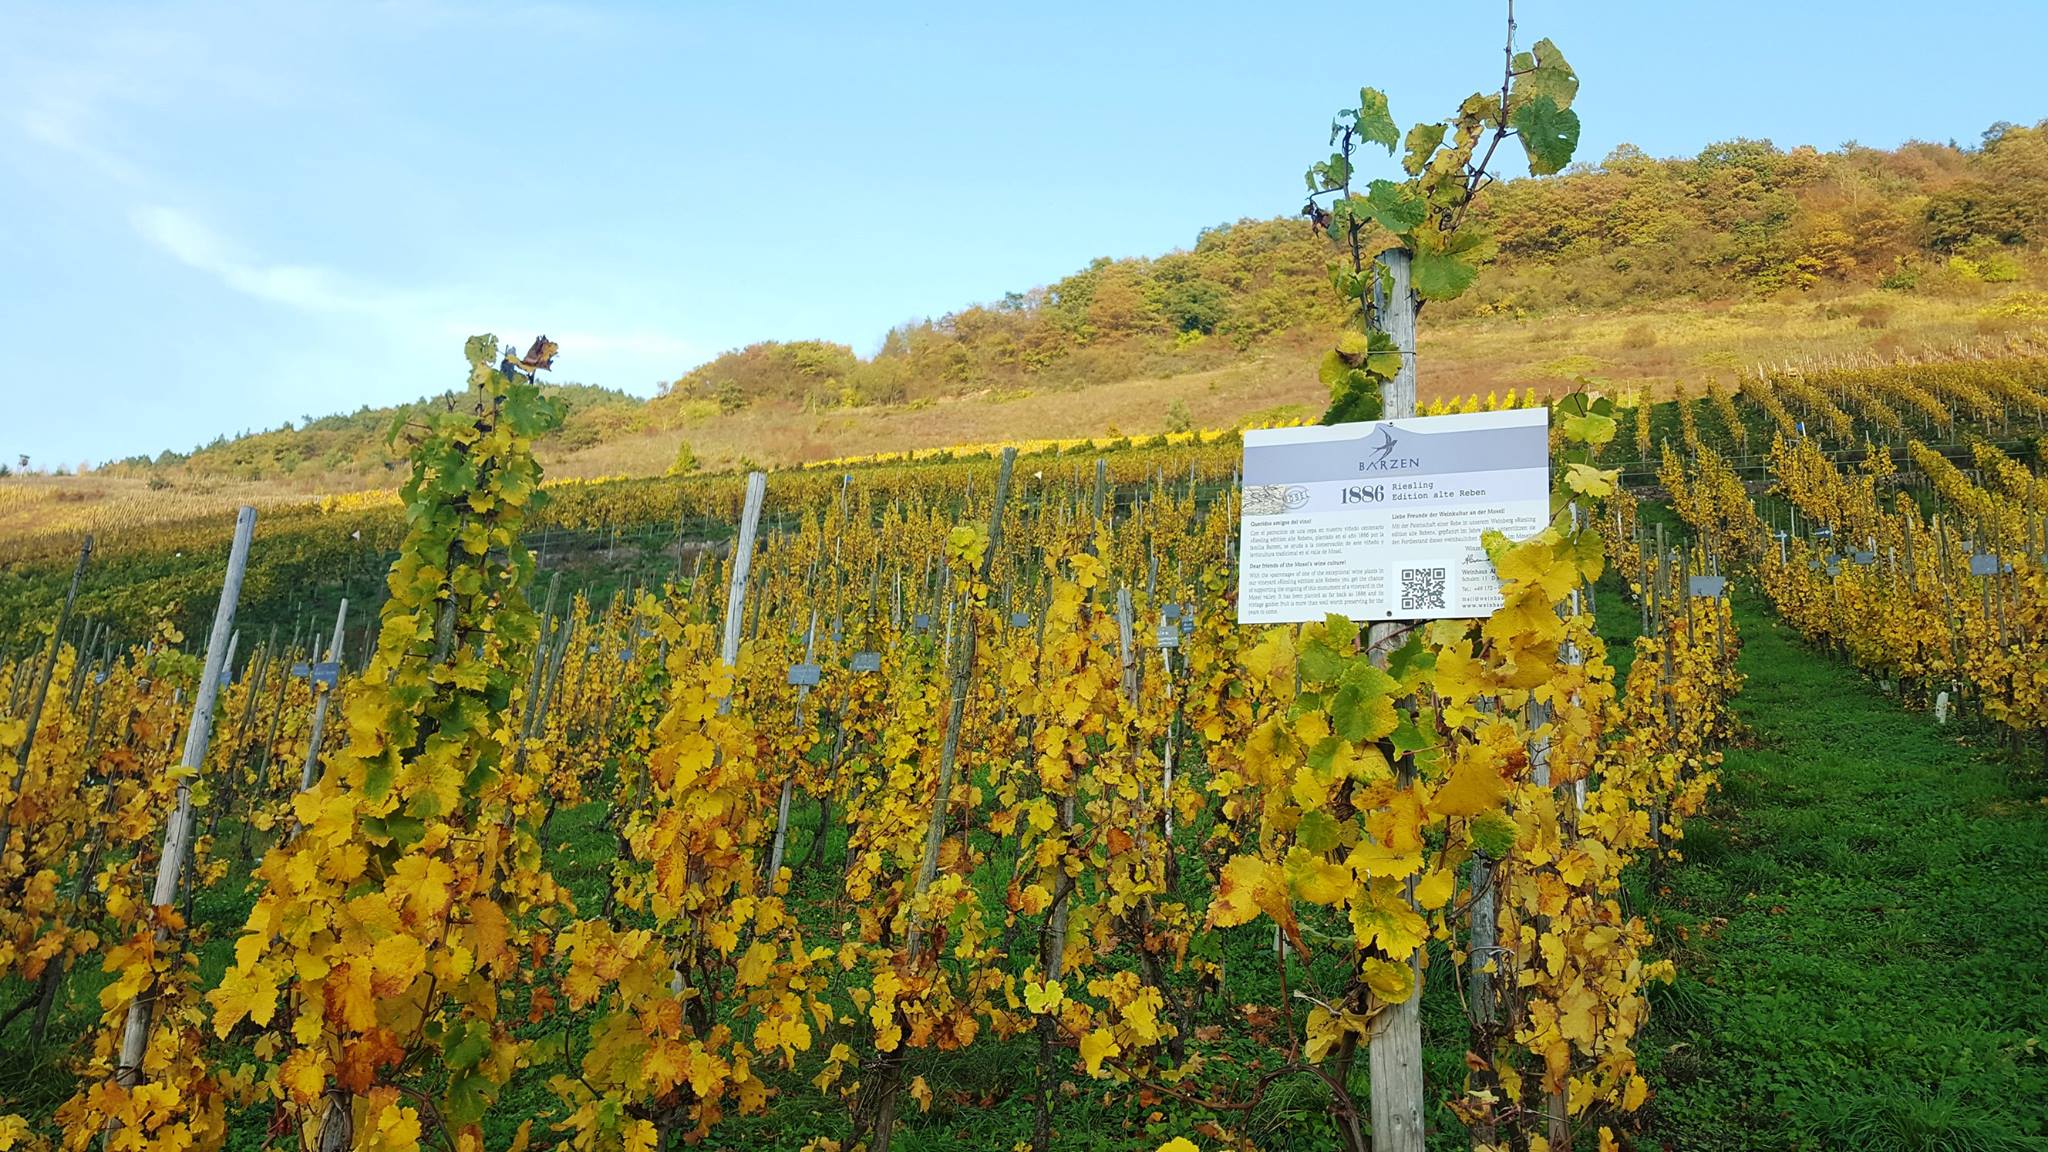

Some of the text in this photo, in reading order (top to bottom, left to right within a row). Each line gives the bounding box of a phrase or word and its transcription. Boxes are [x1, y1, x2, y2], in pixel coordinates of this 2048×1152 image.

[1358, 458, 1420, 471] BARZEN
[1392, 481, 1434, 491] Riesling
[1341, 485, 1385, 504] 1886
[1392, 489, 1486, 501] Edition alte Reben
